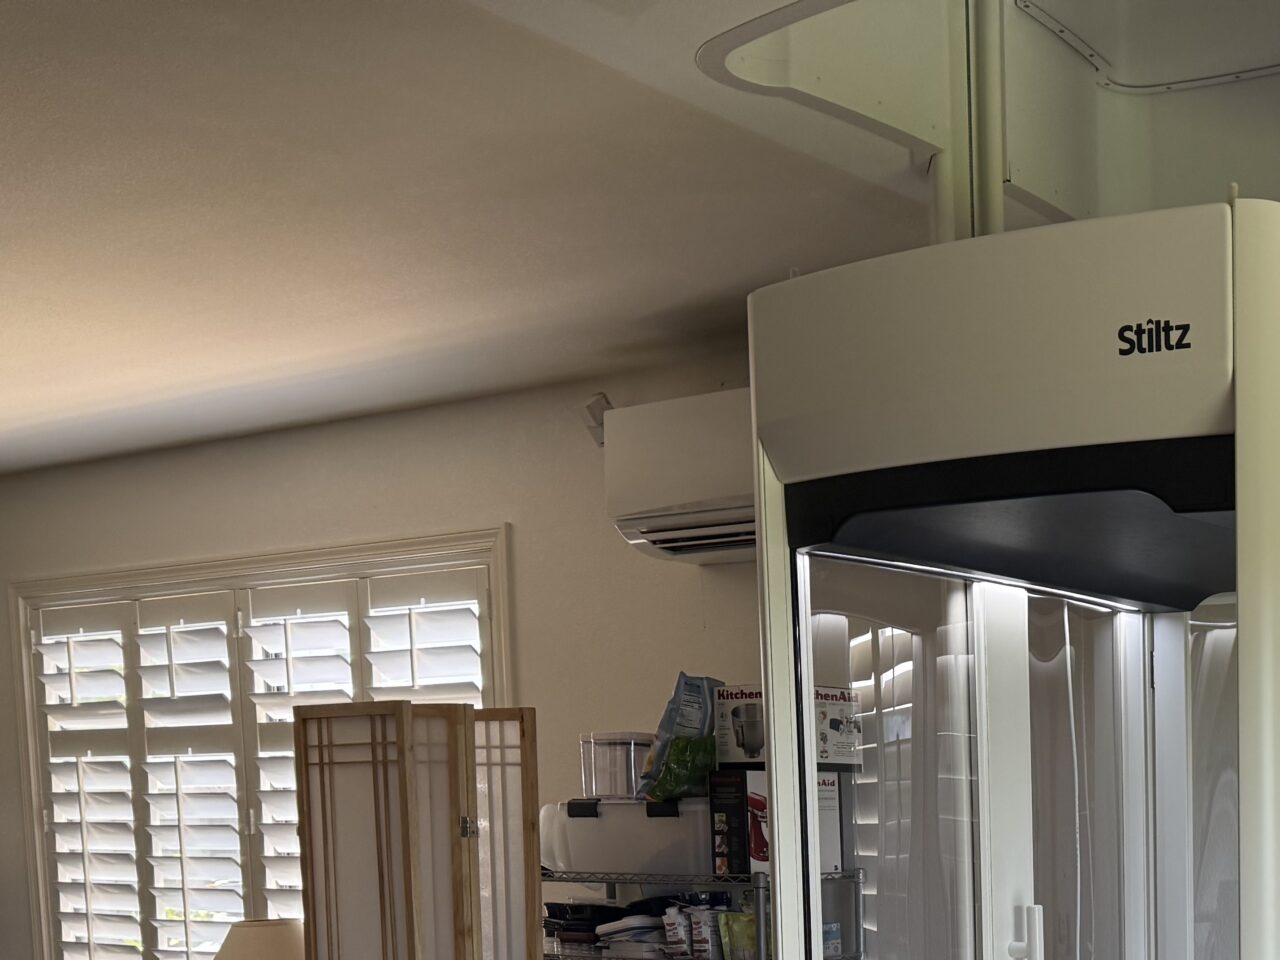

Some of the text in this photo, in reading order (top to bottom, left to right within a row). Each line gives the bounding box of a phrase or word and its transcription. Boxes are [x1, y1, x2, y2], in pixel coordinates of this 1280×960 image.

[1118, 318, 1191, 356] Stiltz
[717, 689, 762, 700] Kitchen
[816, 690, 858, 703] henAid
